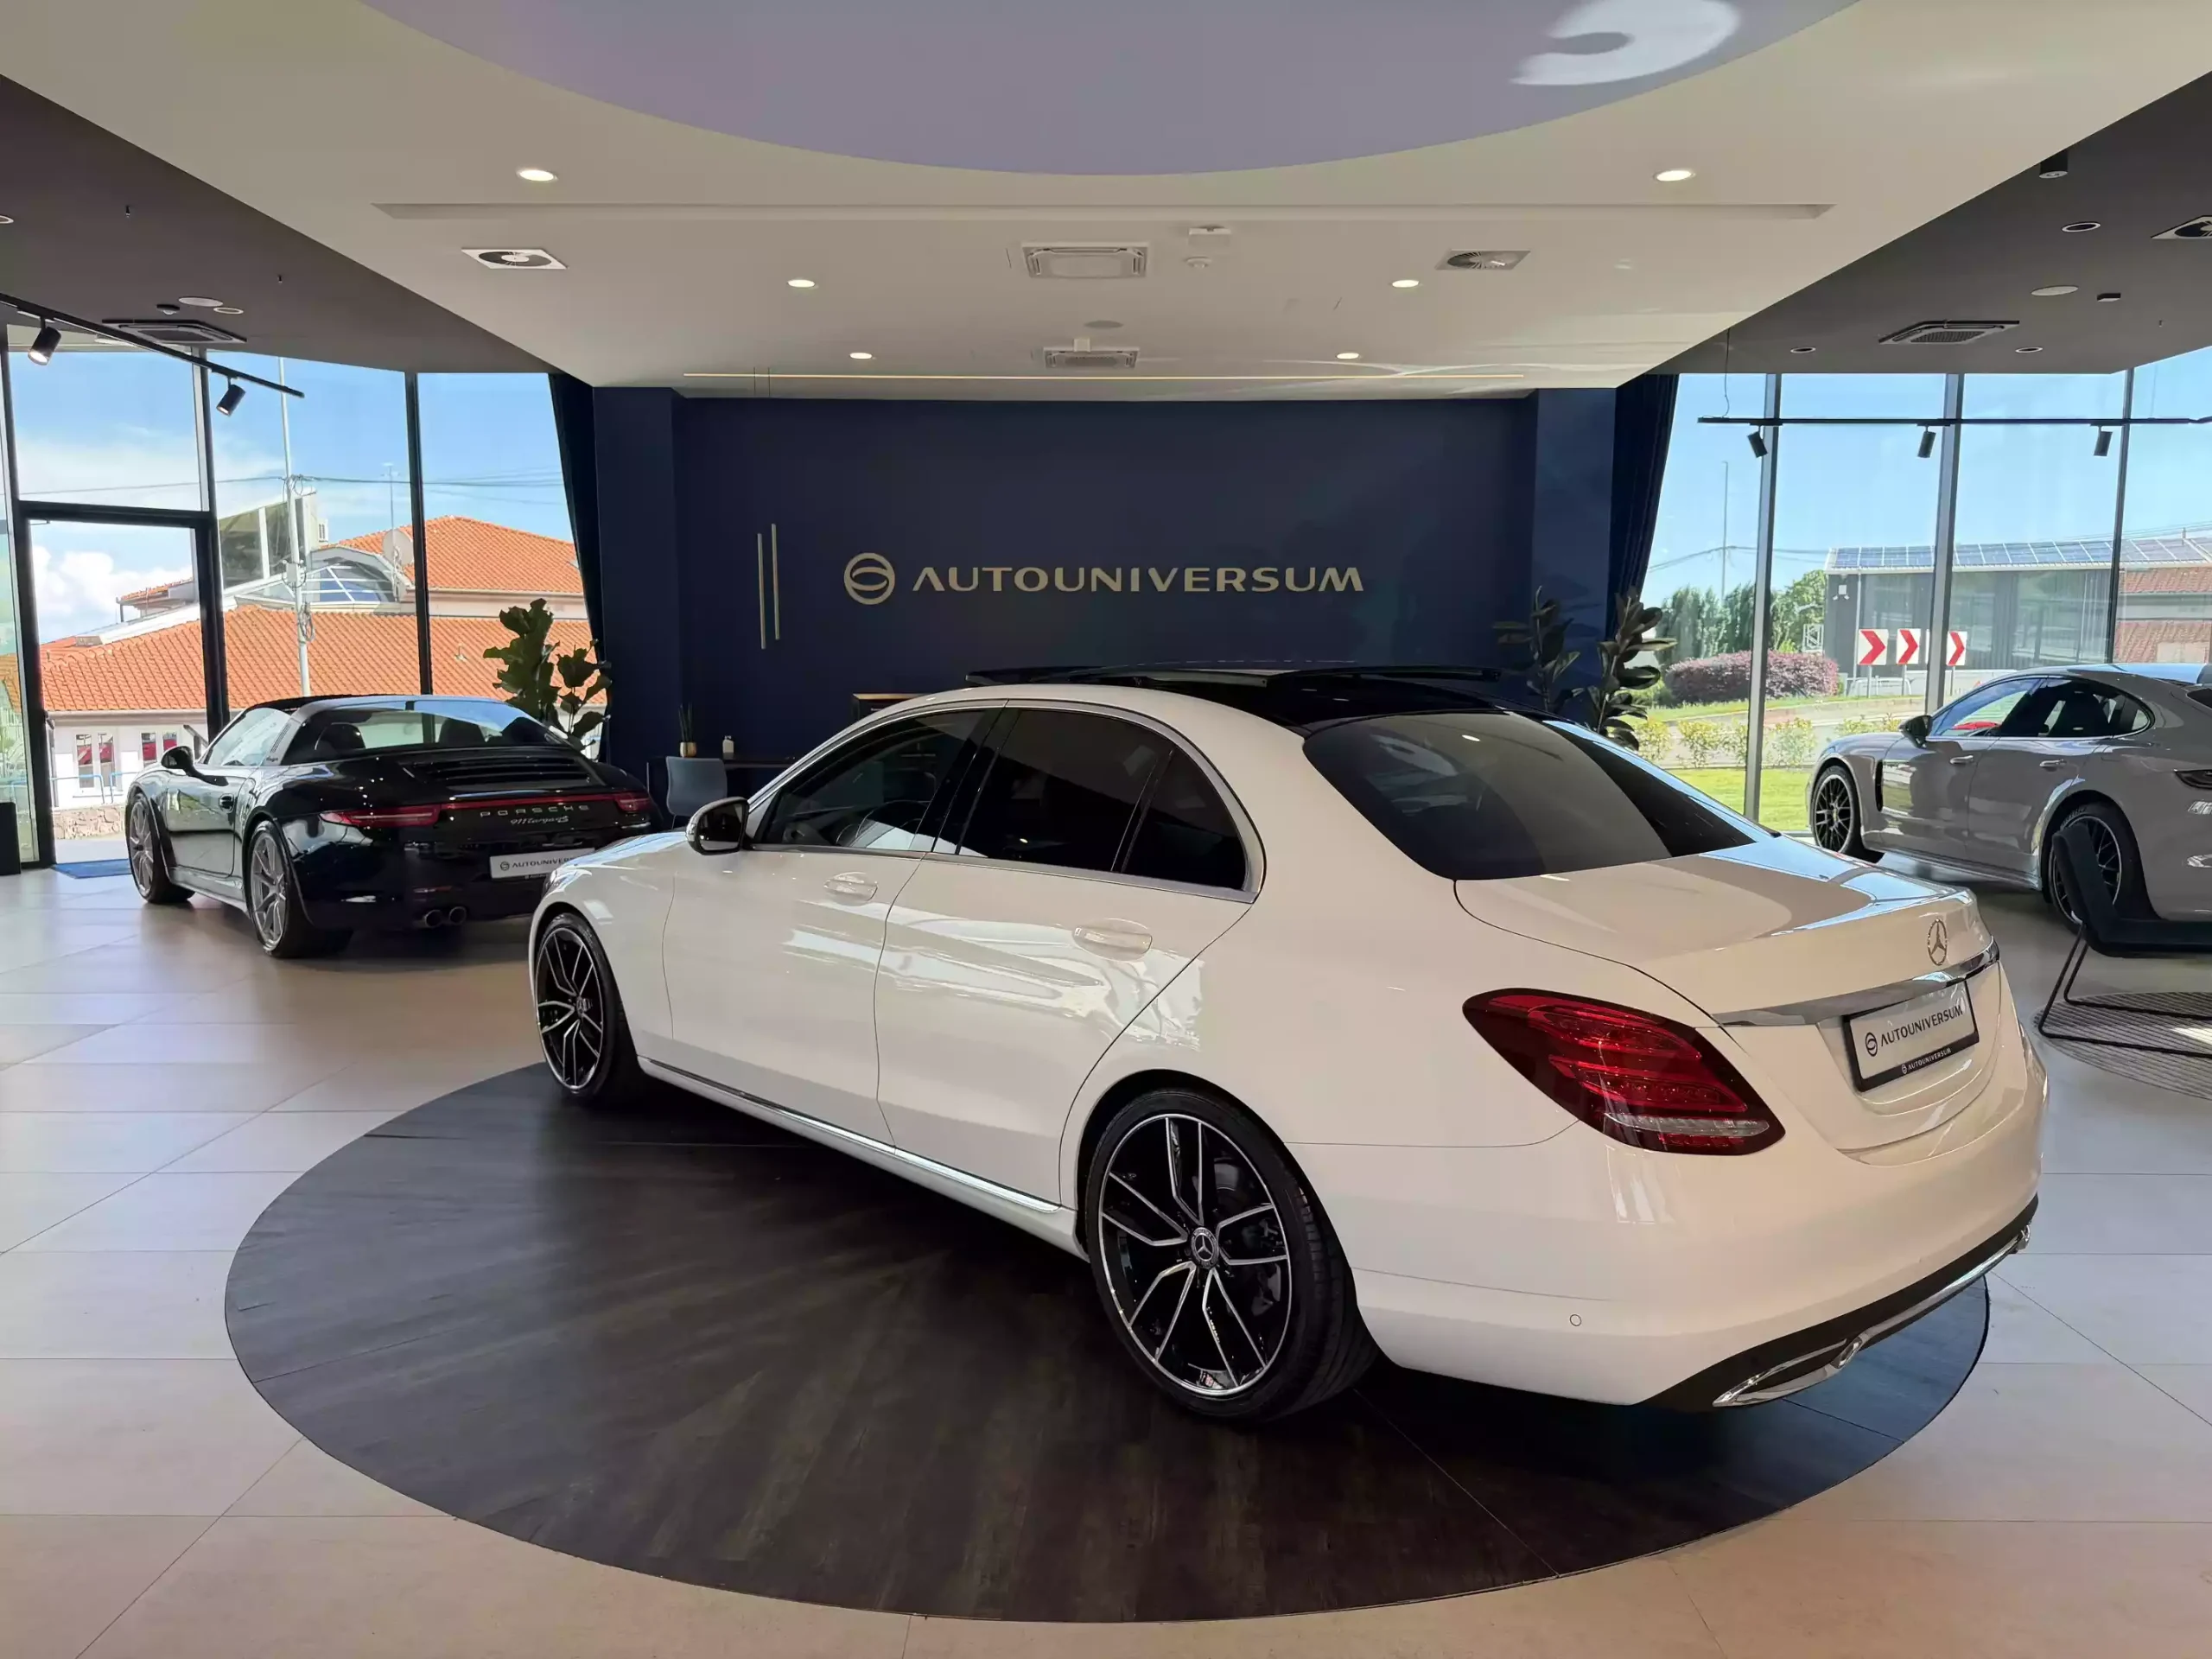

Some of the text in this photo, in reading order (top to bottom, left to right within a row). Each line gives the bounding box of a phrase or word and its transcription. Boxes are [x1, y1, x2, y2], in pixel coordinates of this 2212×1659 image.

[912, 567, 1363, 592] AUTOUNIVERSUM
[480, 804, 589, 817] PORSCHE
[1880, 1004, 1963, 1047] AUTOUNIVERSUM
[1907, 1047, 1952, 1071] AUTOUNIVERSUM
